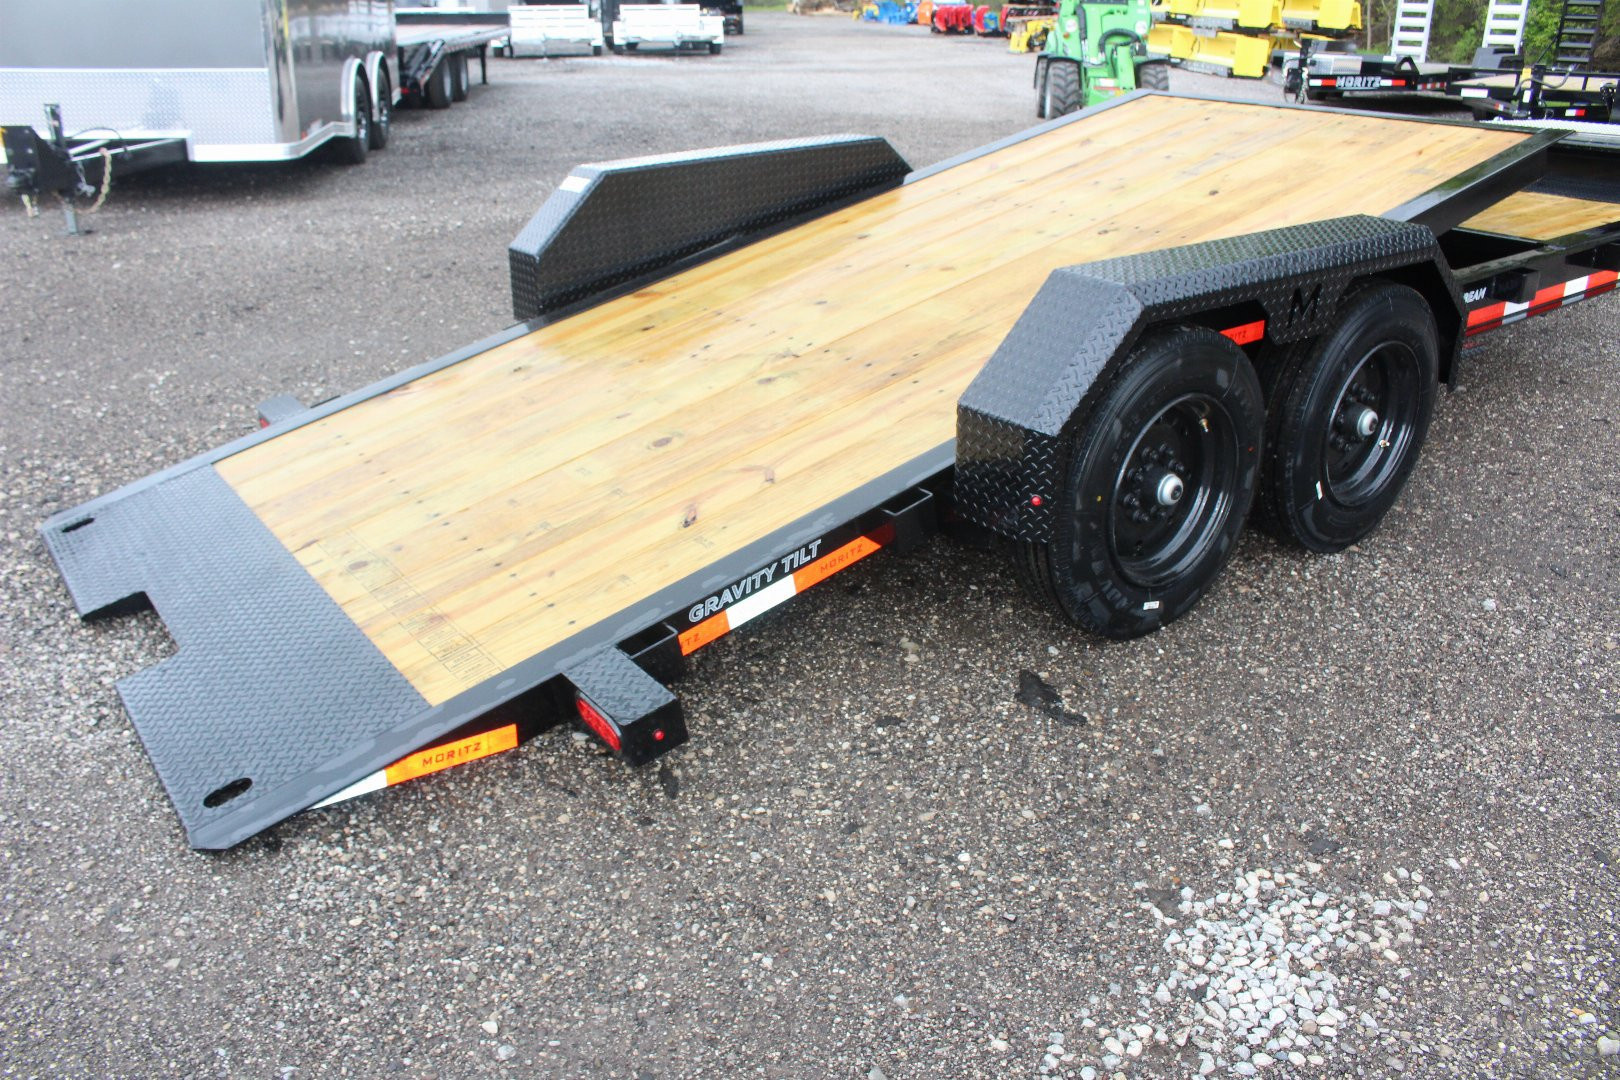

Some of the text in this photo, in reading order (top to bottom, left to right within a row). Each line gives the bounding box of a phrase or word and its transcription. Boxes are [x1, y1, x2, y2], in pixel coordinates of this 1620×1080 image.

[1336, 76, 1381, 88] MORITZ
[820, 543, 863, 574] MORITZ
[688, 539, 821, 623] GRAVITY TILT
[422, 741, 482, 768] MORITZ
